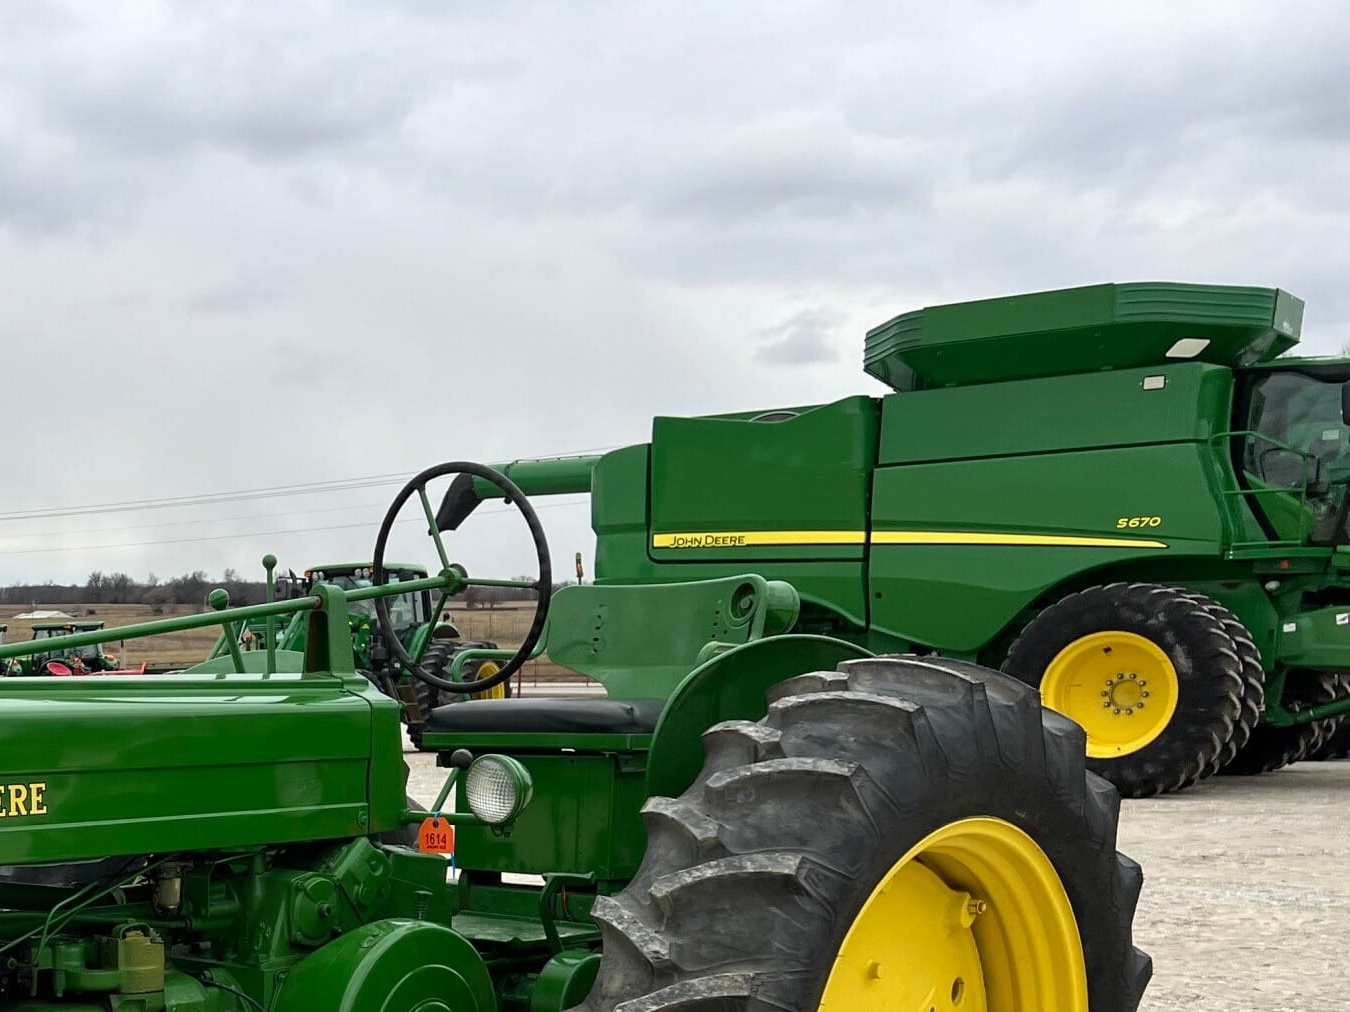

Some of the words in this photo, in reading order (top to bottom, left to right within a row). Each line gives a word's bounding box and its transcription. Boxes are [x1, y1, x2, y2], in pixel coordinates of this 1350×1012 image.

[1116, 516, 1161, 528] S670
[670, 536, 703, 546] JOHN
[705, 535, 746, 545] DEERE
[425, 832, 447, 845] 1614
